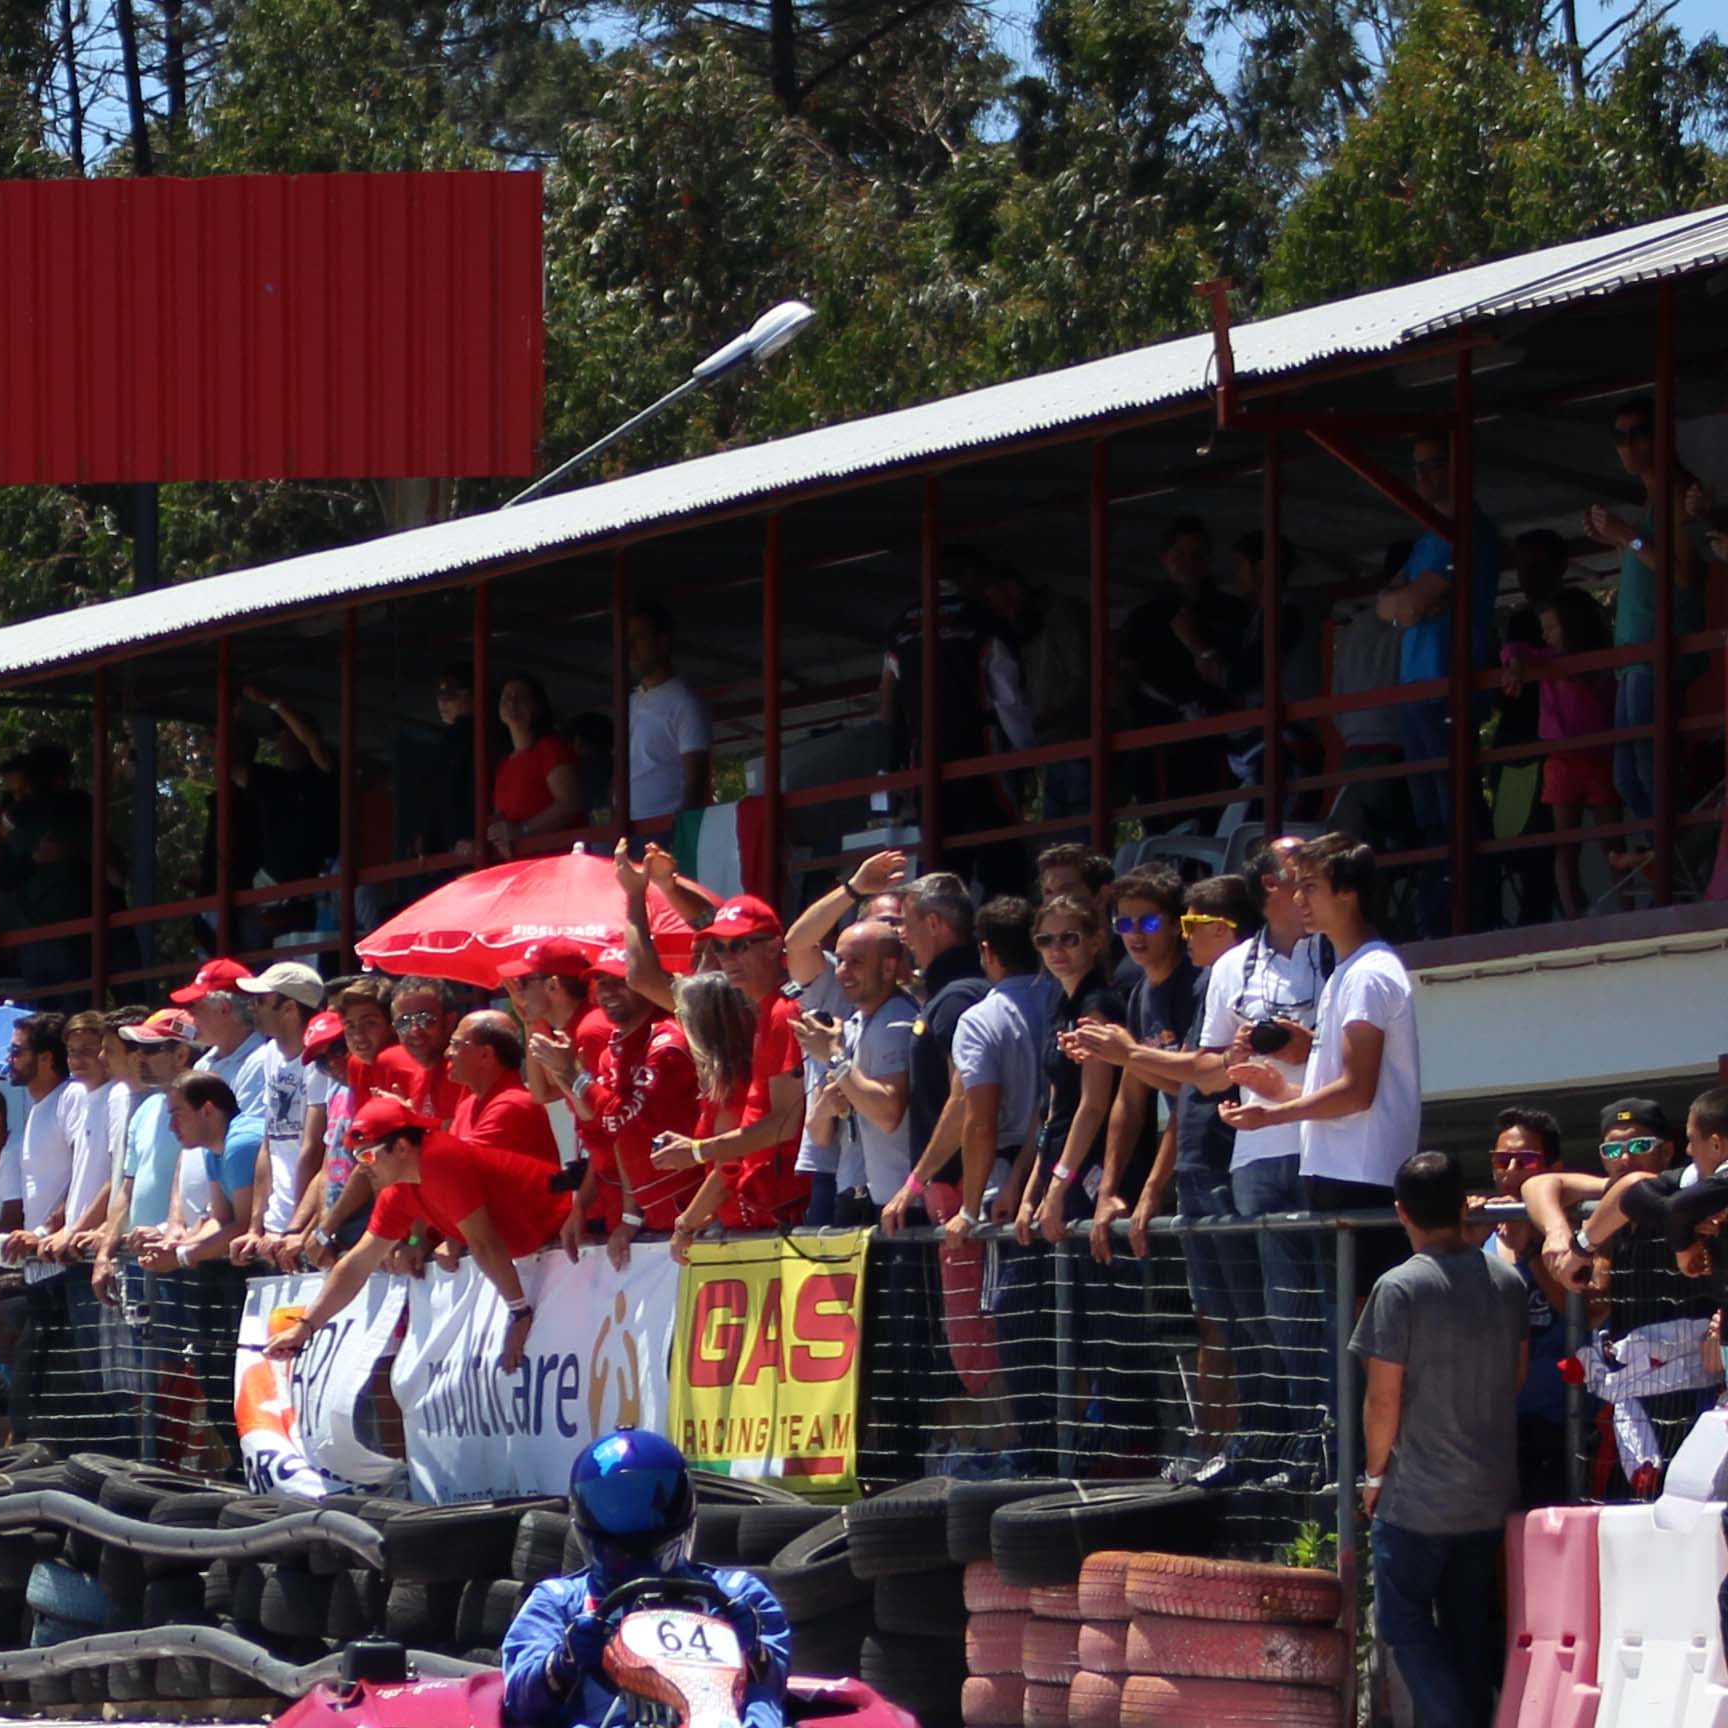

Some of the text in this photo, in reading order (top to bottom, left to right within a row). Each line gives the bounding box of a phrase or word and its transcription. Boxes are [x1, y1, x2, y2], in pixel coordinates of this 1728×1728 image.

[688, 1272, 858, 1388] GAS
[422, 1333, 580, 1438] multicare
[683, 1412, 852, 1455] RACING TEAM
[656, 1619, 713, 1656] 64
